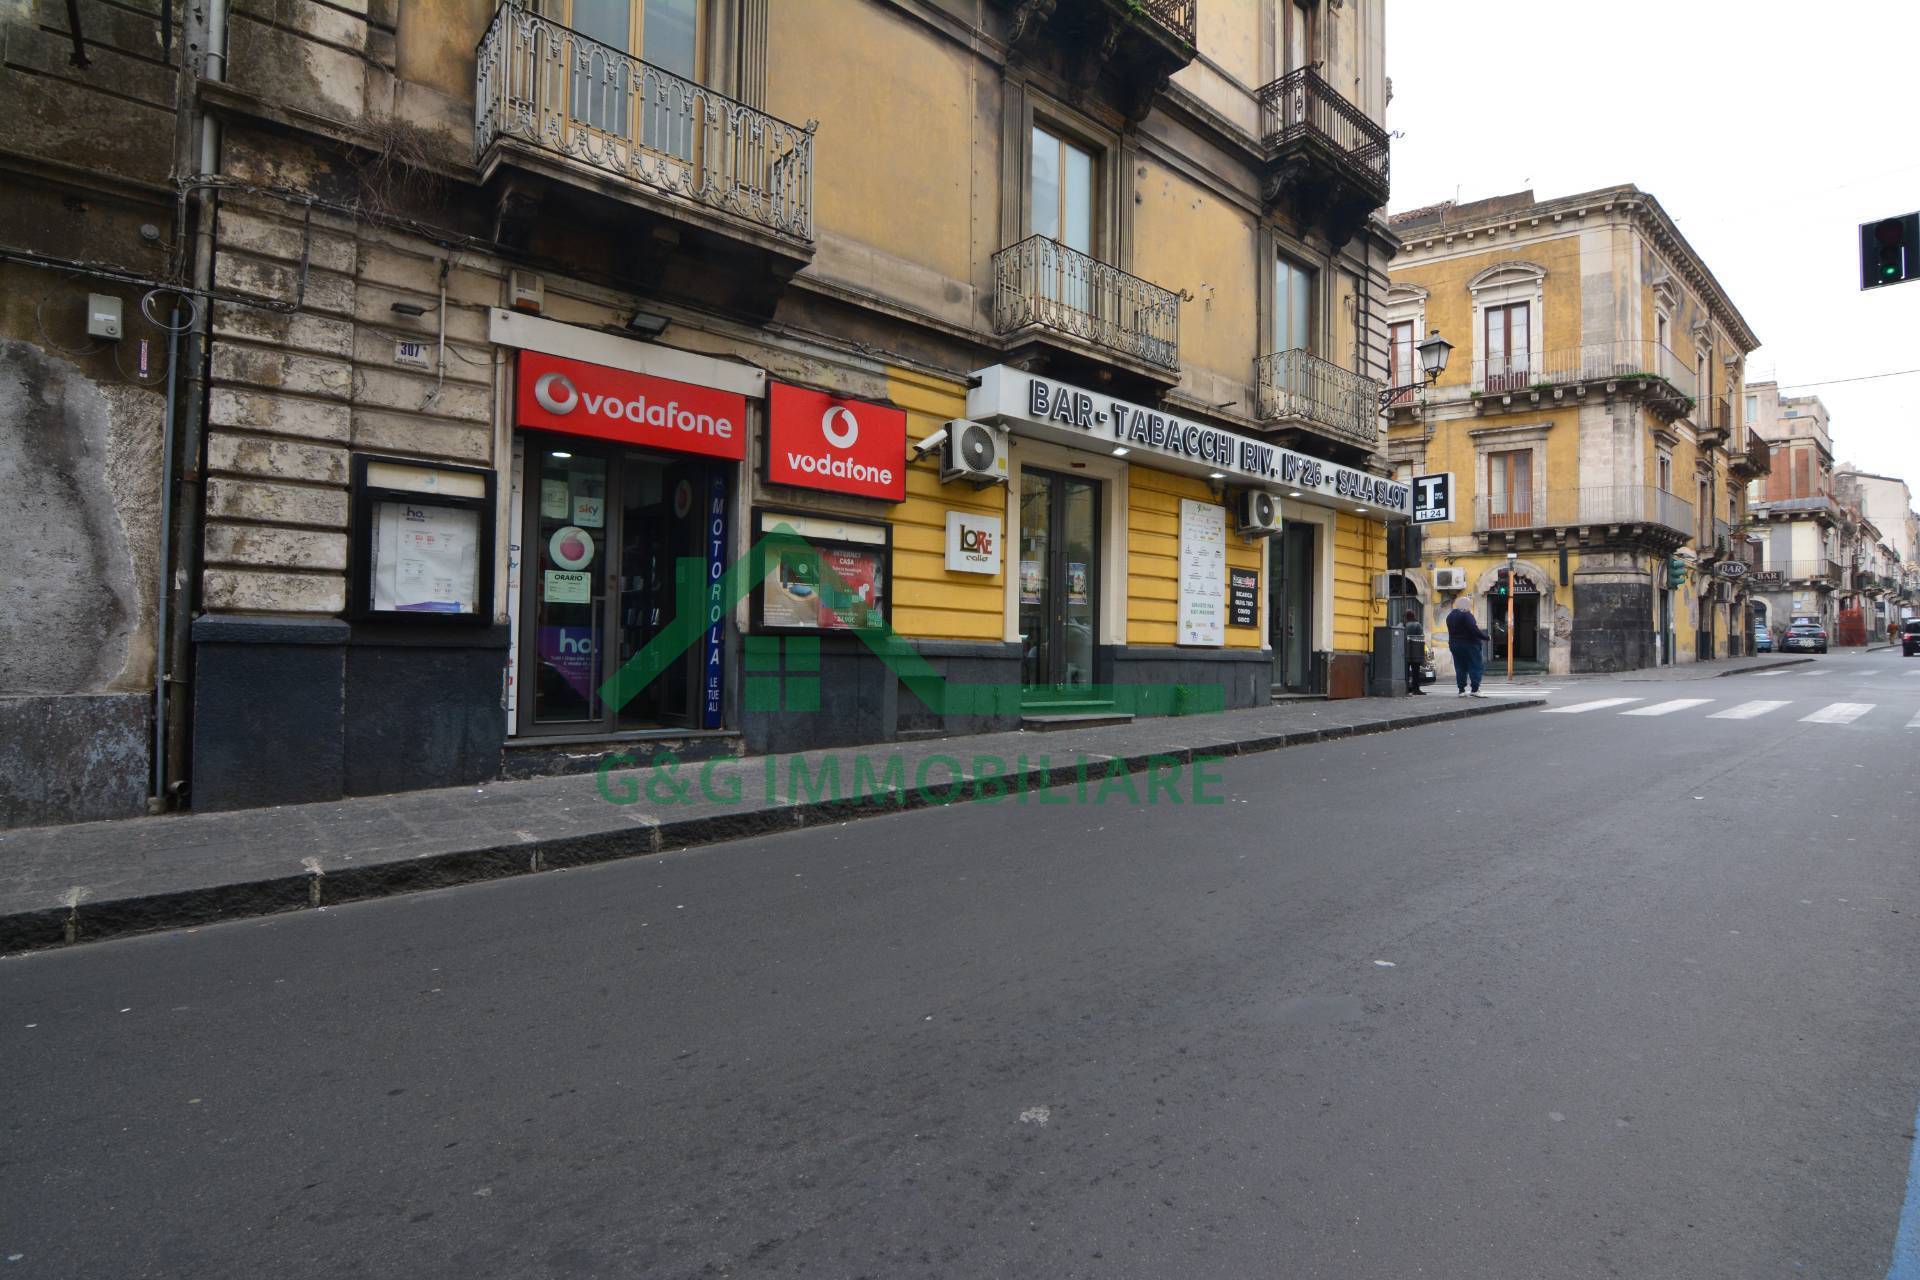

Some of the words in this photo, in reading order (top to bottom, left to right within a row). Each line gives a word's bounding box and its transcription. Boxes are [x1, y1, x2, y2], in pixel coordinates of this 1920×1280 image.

[401, 342, 420, 357] 307
[582, 392, 732, 438] vodafone
[787, 452, 892, 485] vodafone
[1241, 441, 1279, 477] RIV.
[1336, 469, 1374, 501] SALA
[1374, 480, 1408, 510] SLOT
[1418, 477, 1443, 509] T
[578, 504, 598, 516] sky
[1420, 511, 1427, 519] H
[1430, 510, 1441, 518] 24
[1721, 564, 1742, 573] BAR
[710, 498, 724, 665] MOTOROLA
[1757, 572, 1777, 580] BAR
[710, 677, 718, 688] LE
[708, 689, 720, 700] TUE
[708, 702, 718, 712] ALI
